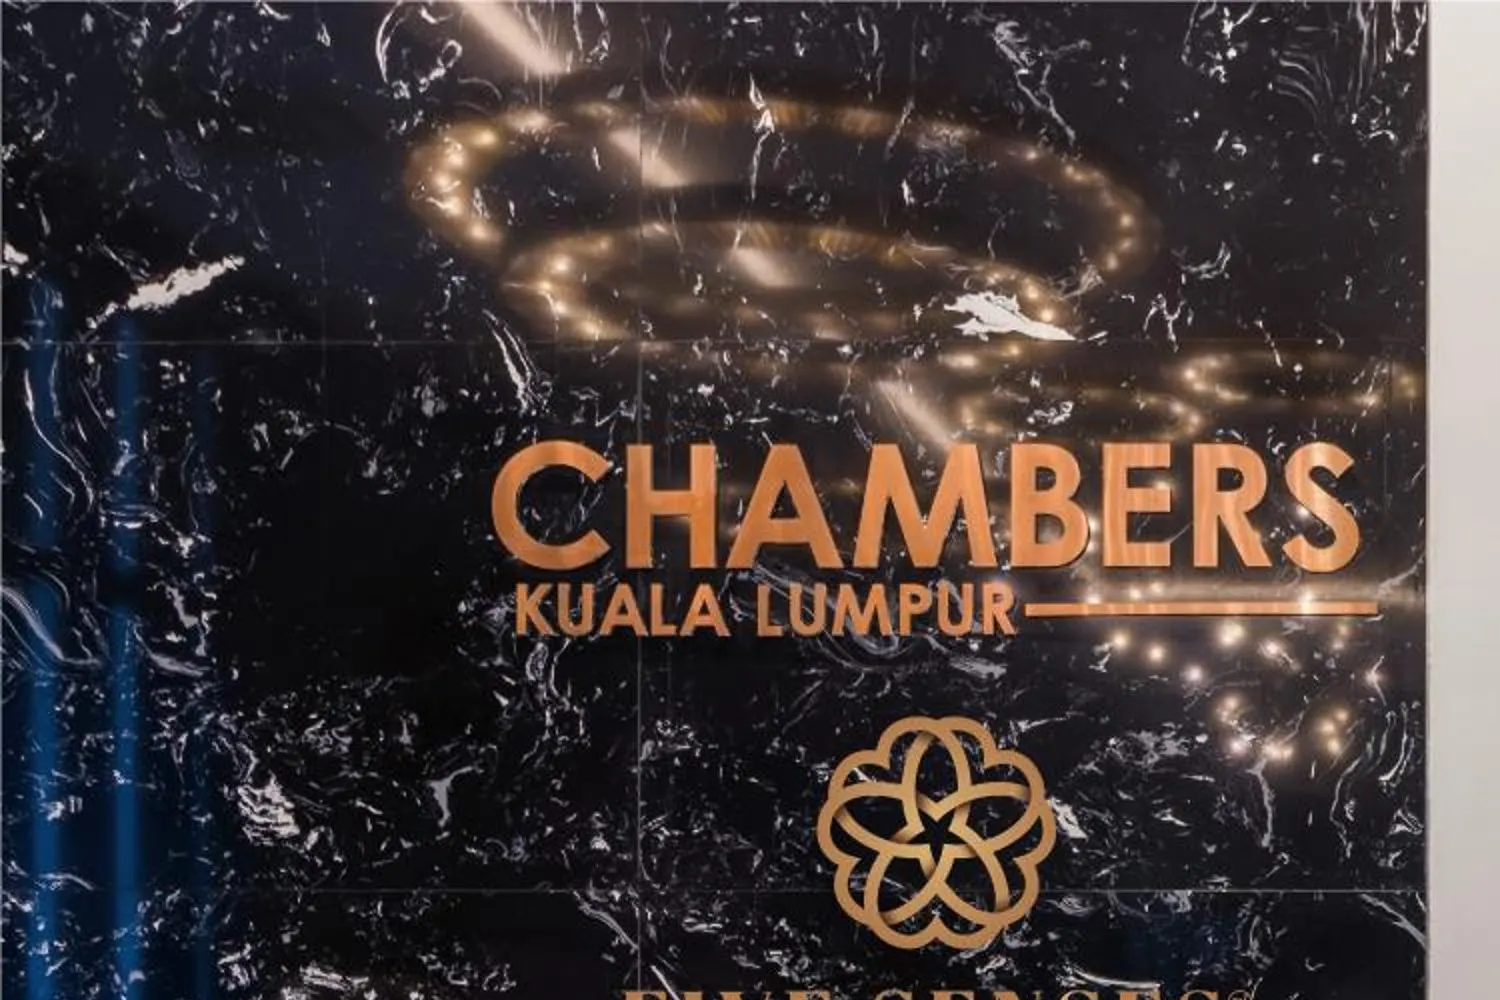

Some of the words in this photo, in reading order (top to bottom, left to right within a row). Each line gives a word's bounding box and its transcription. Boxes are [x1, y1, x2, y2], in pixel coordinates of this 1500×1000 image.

[491, 439, 1361, 573] CHAMBERS
[515, 582, 732, 637] KUALA
[756, 582, 1017, 638] LUMPUR
